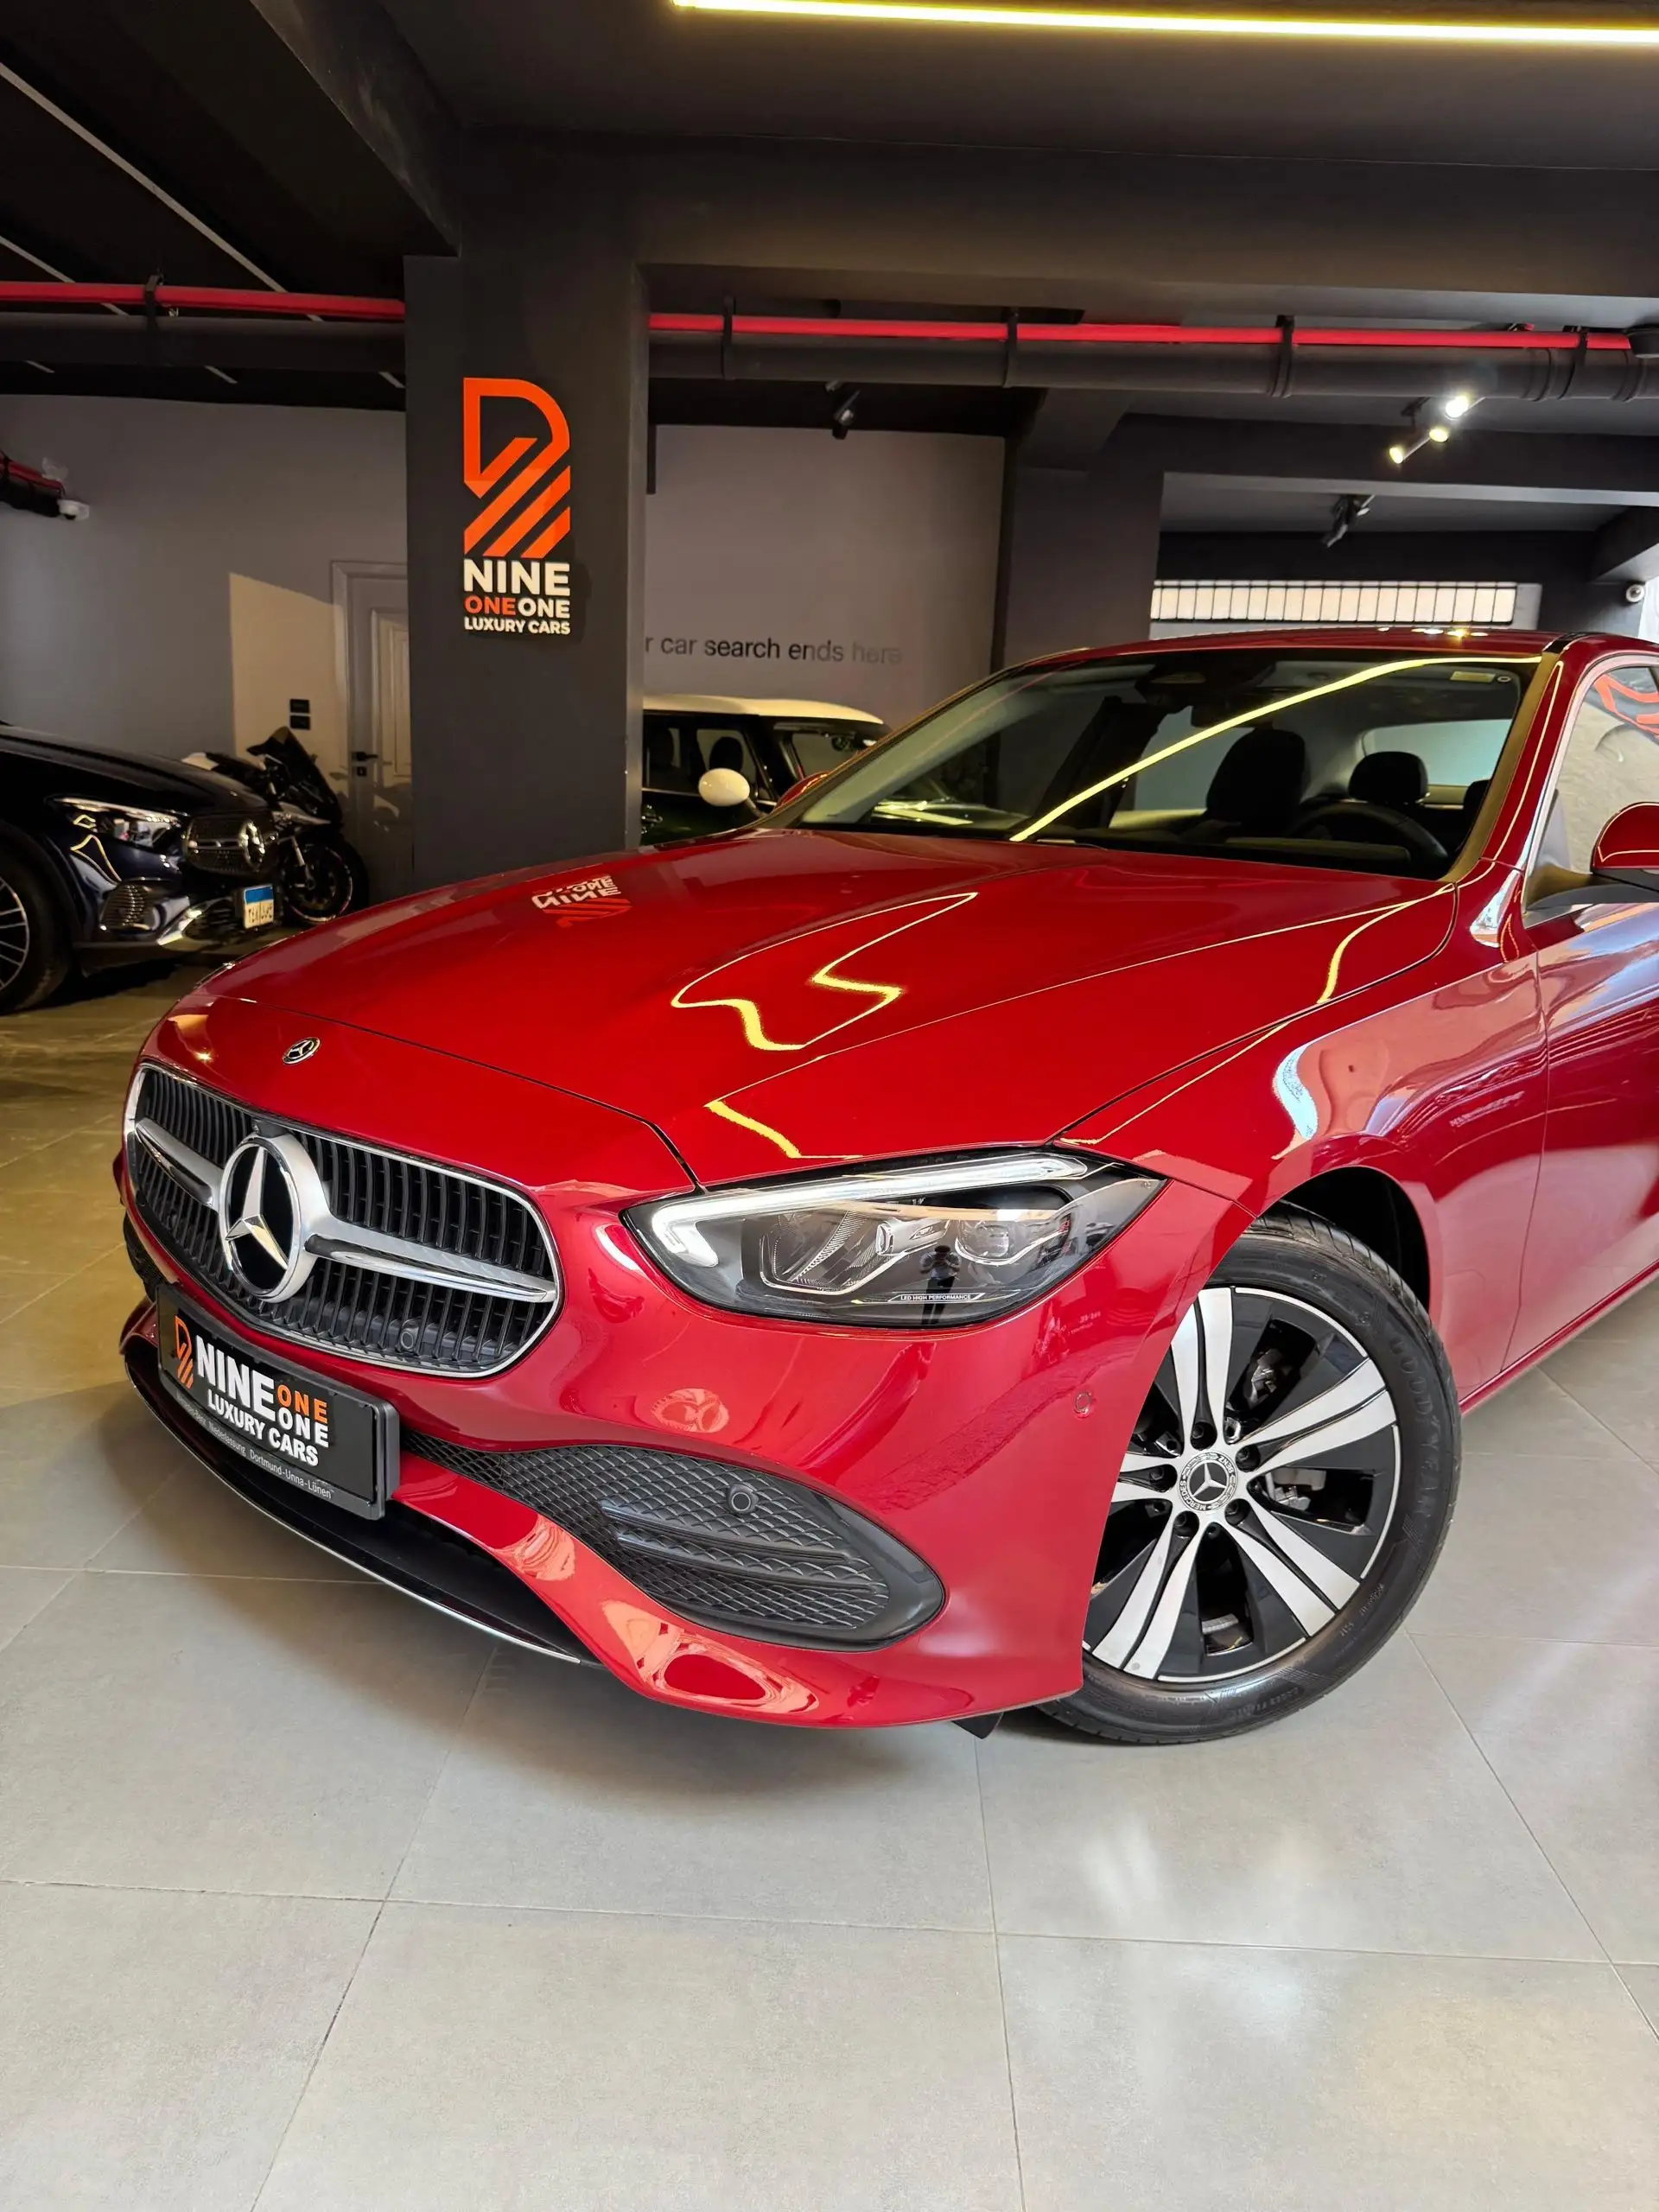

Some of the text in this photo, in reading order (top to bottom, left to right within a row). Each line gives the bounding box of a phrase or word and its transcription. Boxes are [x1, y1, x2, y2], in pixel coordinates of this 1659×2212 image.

[463, 558, 570, 596] NINE
[464, 617, 570, 635] LUXURY CARS
[660, 637, 697, 655] car
[704, 638, 780, 659] search
[788, 639, 844, 662] ends
[196, 1335, 276, 1422] NINE
[277, 1384, 328, 1424] ONE
[207, 1389, 265, 1440] LUXURY
[268, 1428, 319, 1466] CARS
[277, 1408, 329, 1447] ONE
[1217, 1455, 1235, 1473] BENZ
[1179, 1480, 1207, 1511] MERCEDES
